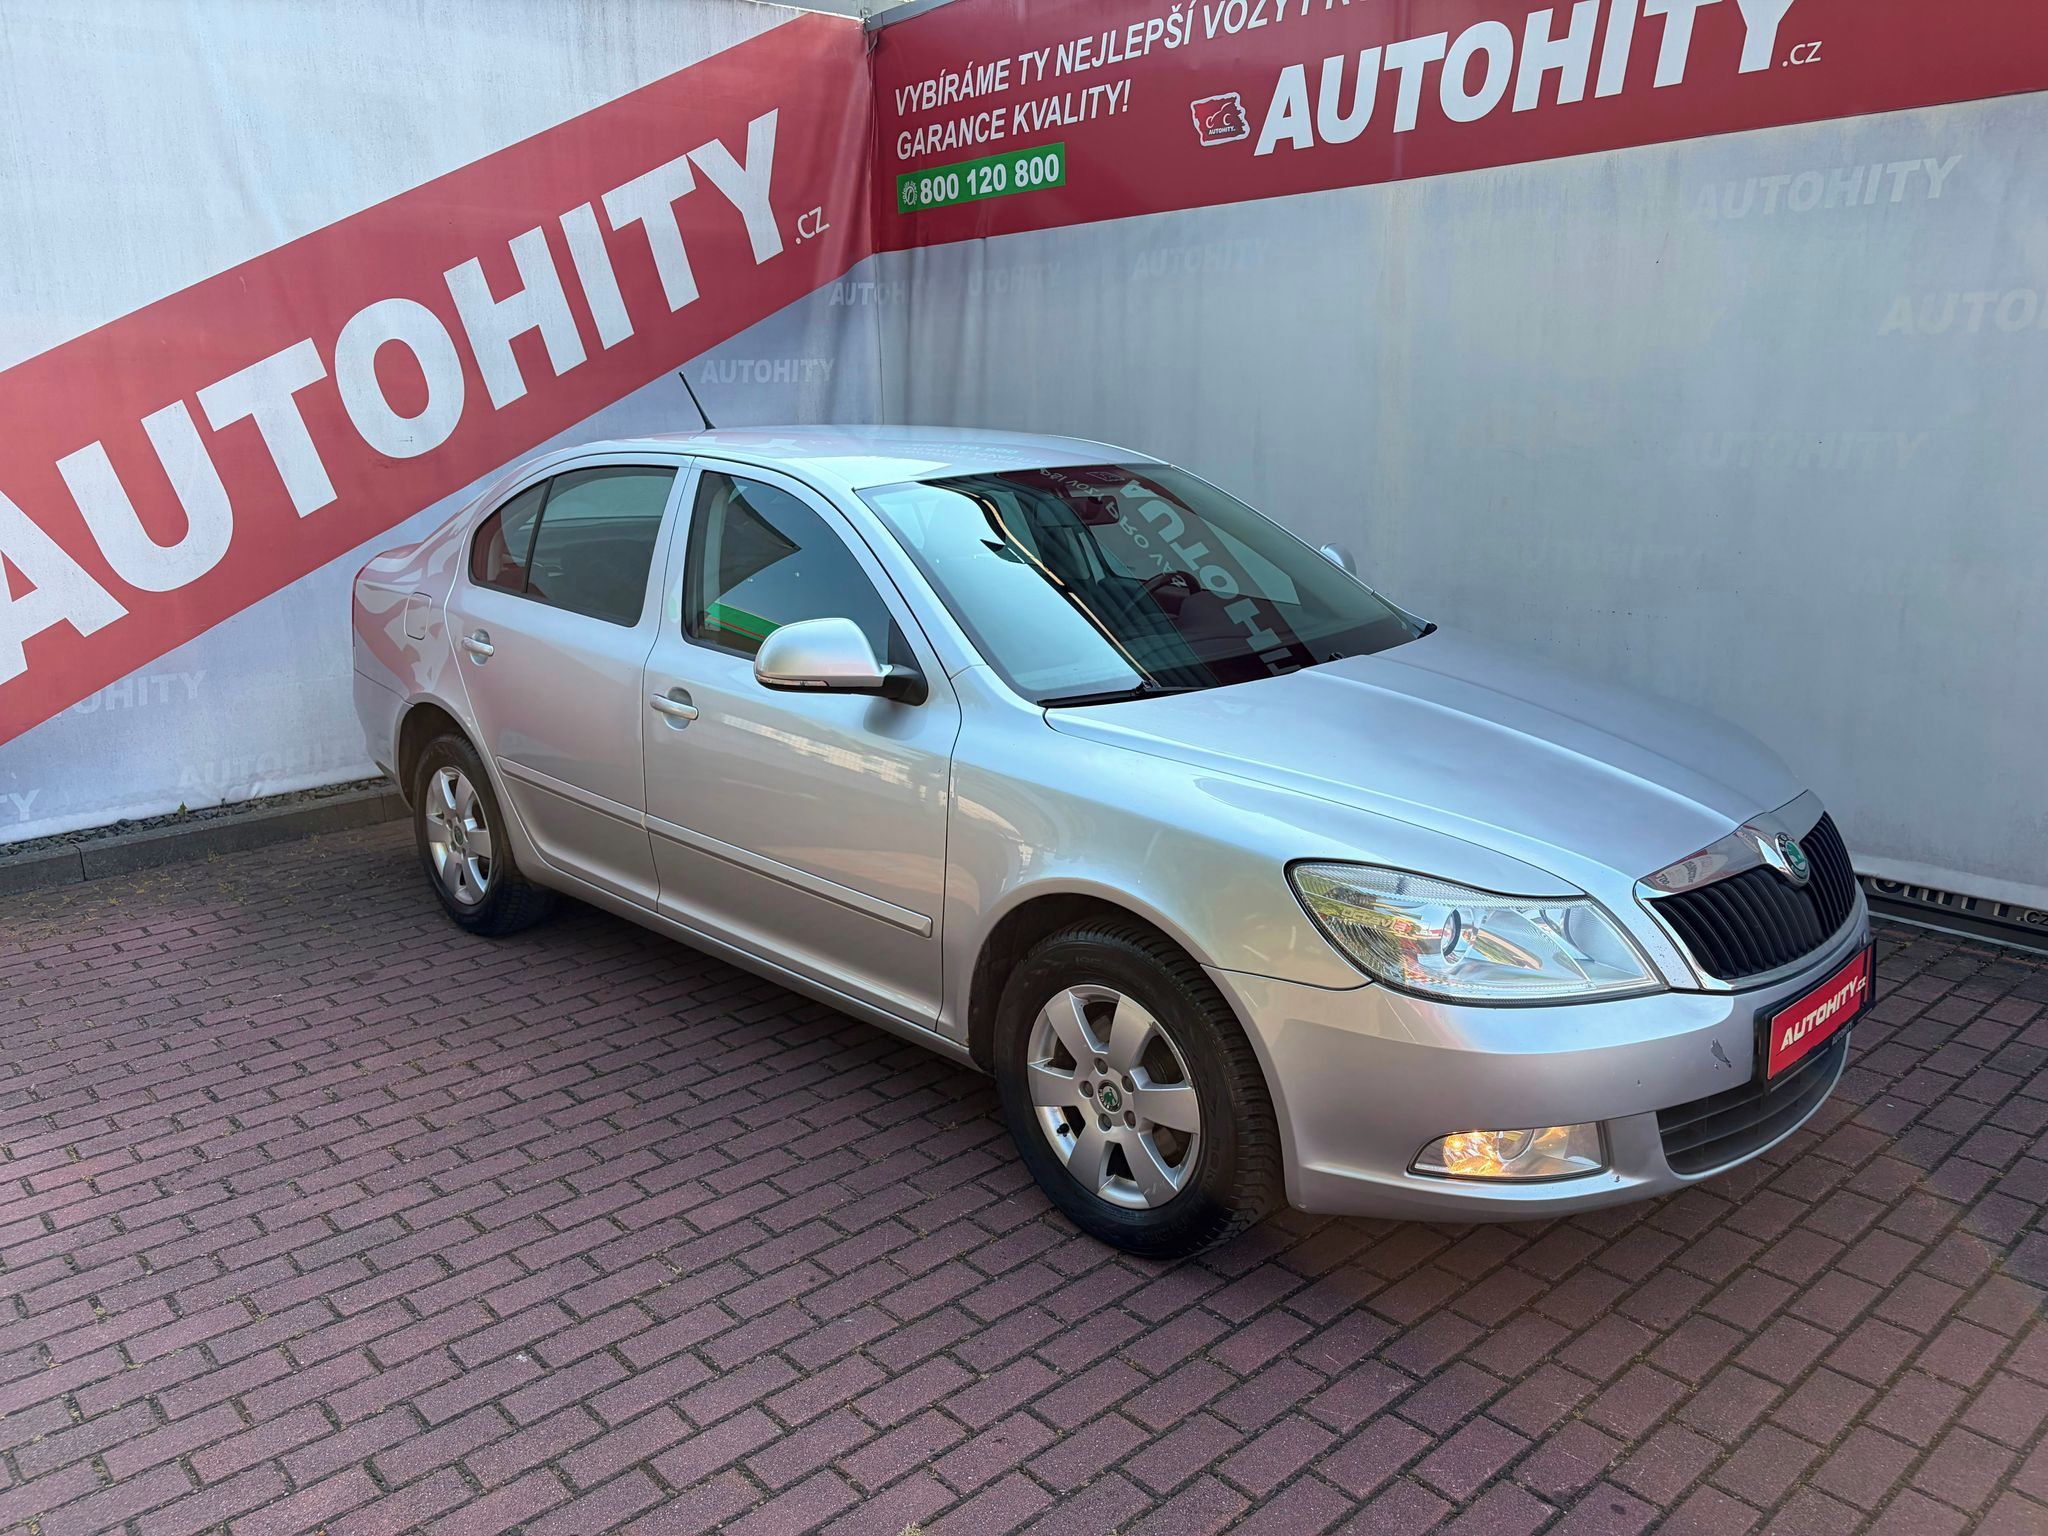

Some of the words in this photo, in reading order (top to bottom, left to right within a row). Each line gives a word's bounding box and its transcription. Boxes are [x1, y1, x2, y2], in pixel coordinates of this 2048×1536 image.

[895, 58, 1011, 116] VYBÍRÁME
[1018, 47, 1051, 86] TY
[1055, 1, 1195, 77] NEJLEPŠÍ
[896, 107, 1007, 161] GARANCE
[1012, 78, 1132, 136] KVALITY!
[920, 173, 959, 204] 800
[966, 163, 1007, 196] 120
[1014, 153, 1060, 188] 800
[1692, 155, 1963, 222] AUTOHITY
[700, 357, 835, 387] AUTOHITY
